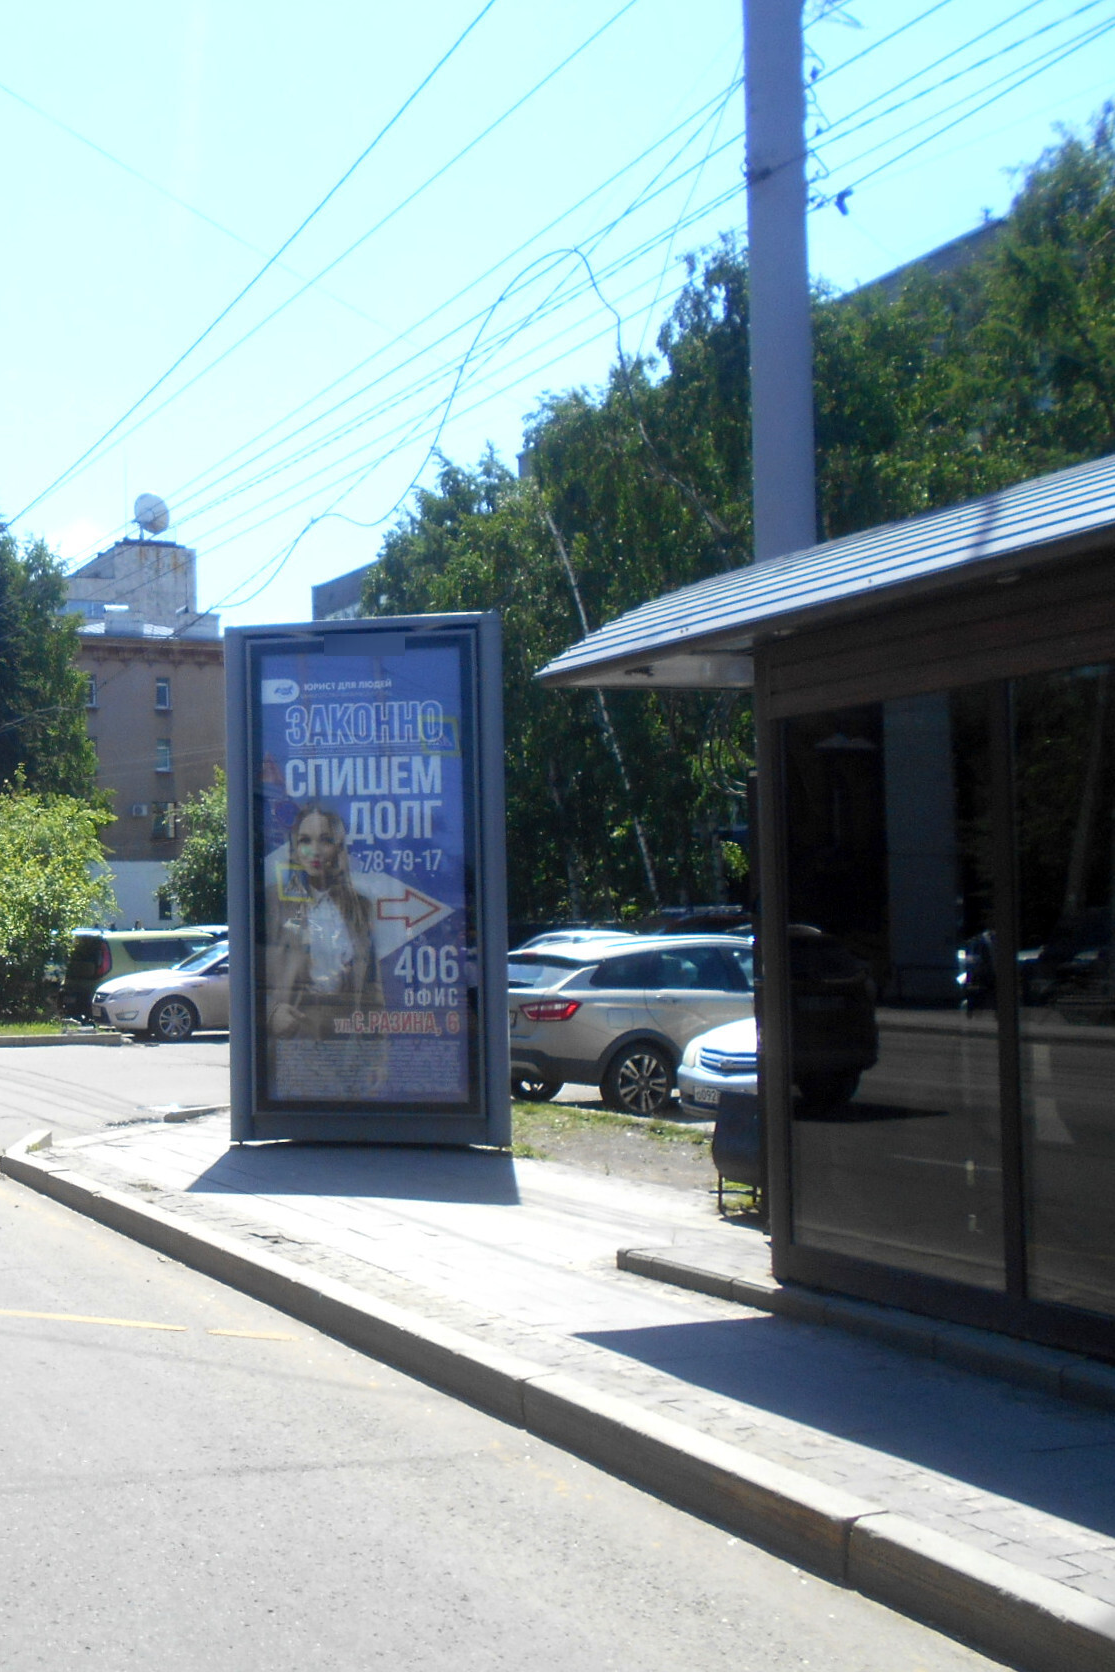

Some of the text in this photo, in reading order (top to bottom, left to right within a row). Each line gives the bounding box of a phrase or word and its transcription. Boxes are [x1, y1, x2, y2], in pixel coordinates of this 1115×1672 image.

[285, 700, 443, 747] ЗАКОННО
[285, 755, 443, 798] СПИШЕМ
[345, 800, 443, 846] ДОЛГ
[362, 849, 443, 872] 78-79-17
[394, 945, 460, 984] 406
[404, 987, 459, 1007] ОФИС
[445, 1010, 460, 1034] 6
